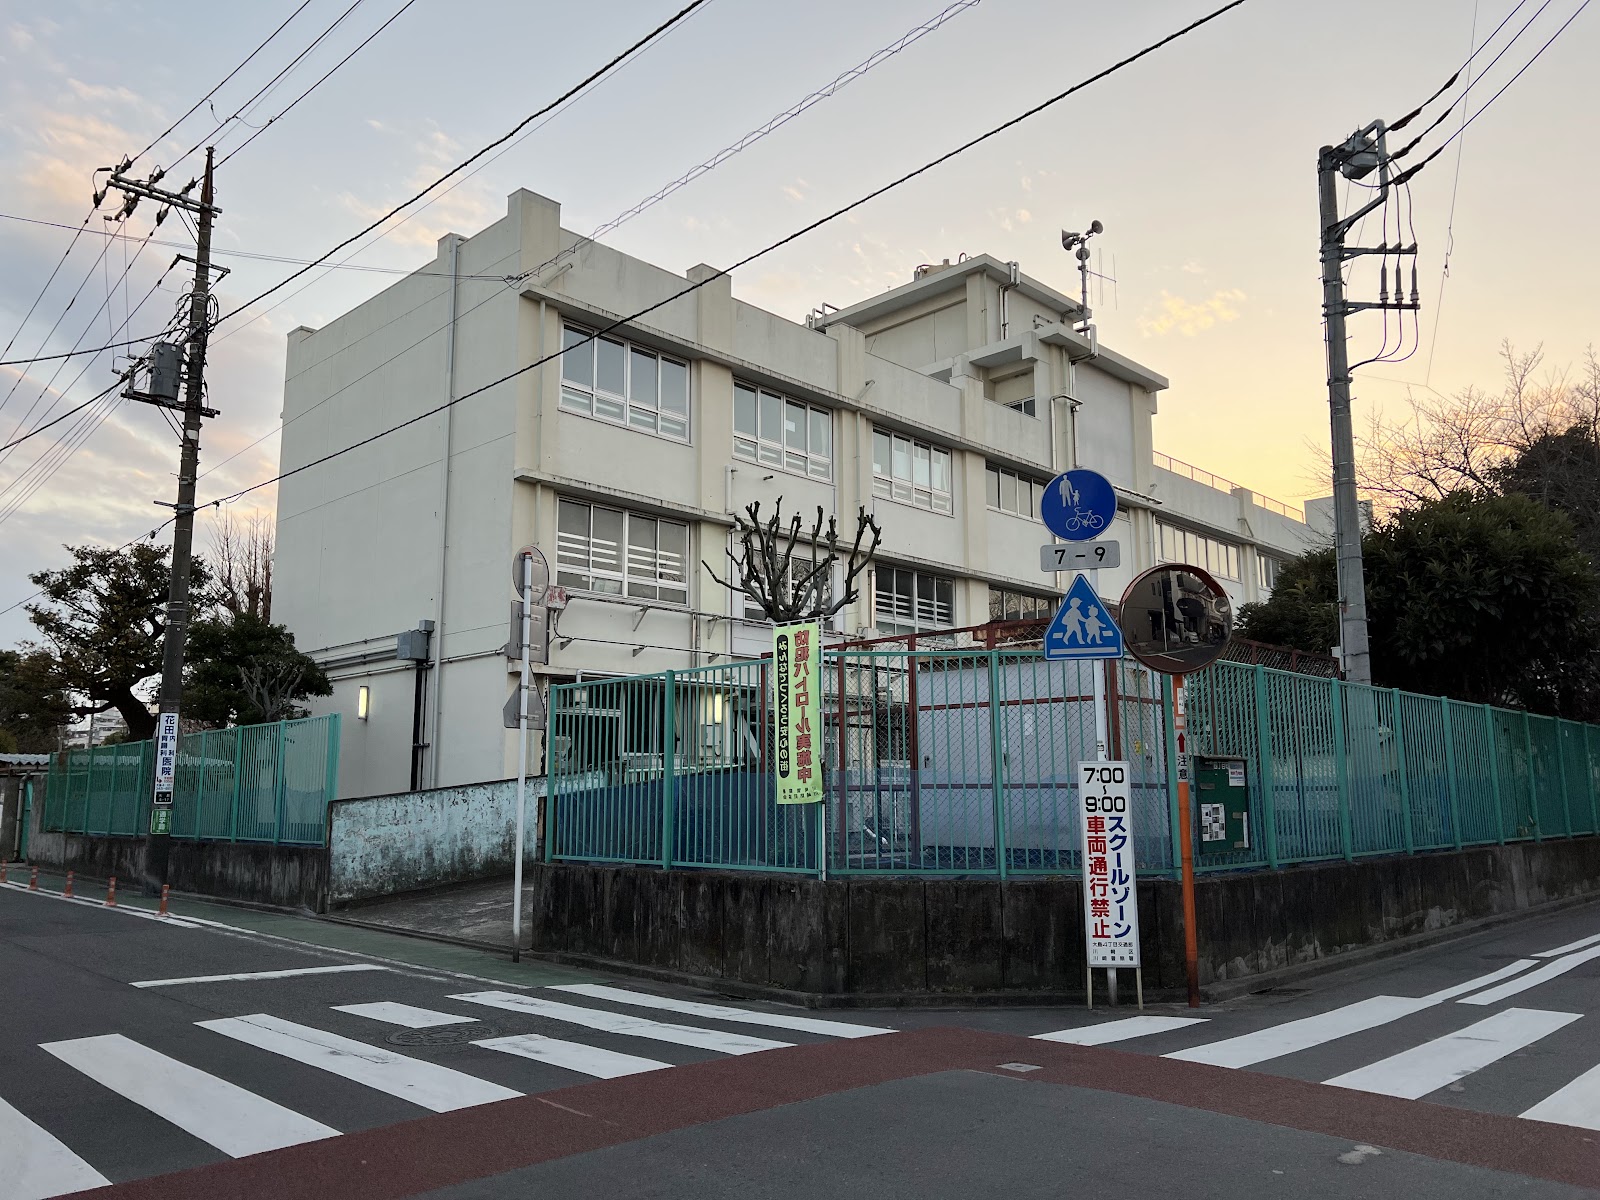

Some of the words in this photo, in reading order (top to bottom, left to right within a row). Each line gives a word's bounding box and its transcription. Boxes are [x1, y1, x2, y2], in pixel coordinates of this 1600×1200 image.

[164, 715, 175, 734] 花田
[161, 757, 172, 776] 医院
[1083, 767, 1125, 784] 7:00
[1177, 755, 1188, 780] 注意
[1085, 796, 1126, 813] 9:00
[1086, 815, 1111, 939] 車両通行禁止
[1108, 816, 1131, 939] スクールゾーン
